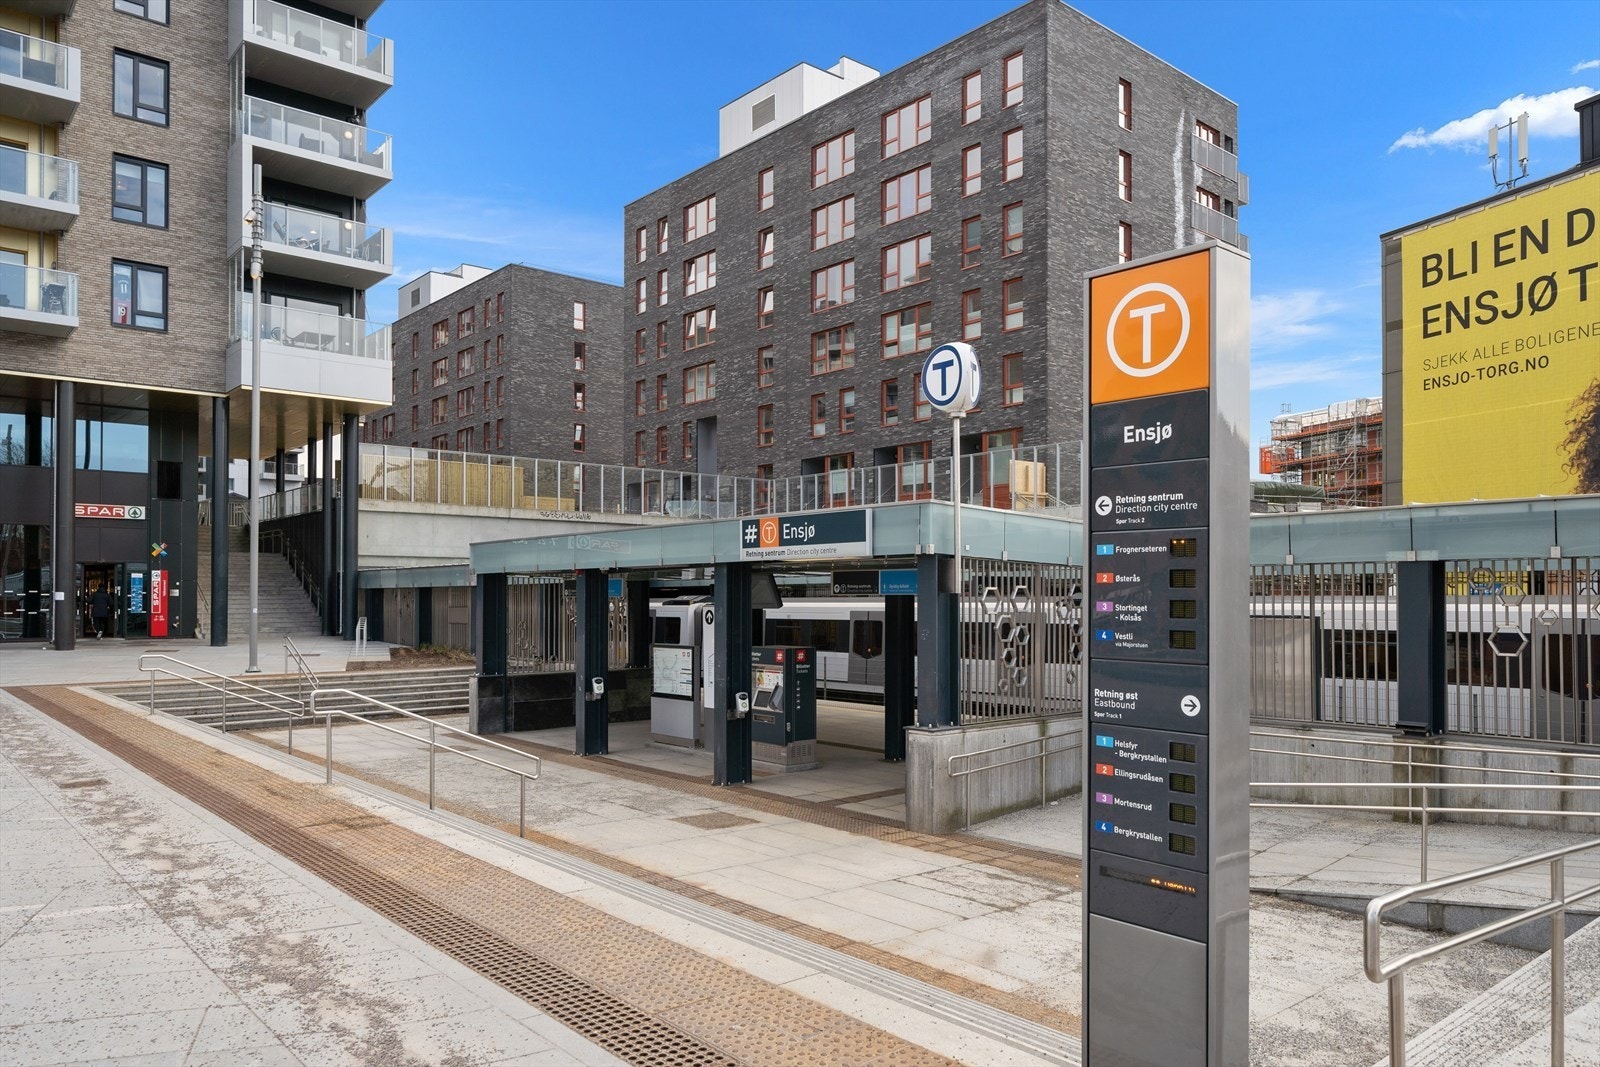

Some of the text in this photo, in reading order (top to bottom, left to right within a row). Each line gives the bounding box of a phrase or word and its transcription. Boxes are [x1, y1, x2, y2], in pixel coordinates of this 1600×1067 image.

[1422, 240, 1478, 288] BLI
[1494, 218, 1549, 268] EN
[117, 306, 126, 317] 19
[1422, 271, 1558, 339] ENSJØ
[1129, 303, 1166, 364] T
[1423, 321, 1600, 372] SJEKK ALLE BOLIGENE
[932, 359, 954, 396] T
[1423, 355, 1550, 391] ENSJO-TORG.NO
[1123, 421, 1173, 444] Ensjø
[1116, 492, 1184, 504] Retning sentrum
[75, 506, 124, 516] SPAR
[1116, 501, 1198, 514] Direction city centre
[783, 522, 816, 542] Ensjø
[746, 547, 837, 558] Retning sentrum Direction city centre
[1116, 544, 1167, 554] Frognerseteren
[1115, 574, 1141, 582] Østerås
[1115, 604, 1148, 613] Stortinget
[1120, 614, 1142, 622] Kolsås
[1114, 632, 1134, 641] Vestli
[1094, 688, 1139, 701] Retning øst
[1094, 698, 1136, 710] Eastbound
[1114, 740, 1138, 750] Helsfyr
[1118, 750, 1167, 764] Bergkrystallen
[1114, 768, 1164, 784] Ellingsrudåsen
[1102, 794, 1153, 811] 3 Mortensrud
[1101, 823, 1163, 843] 4 Bergkrystallen
